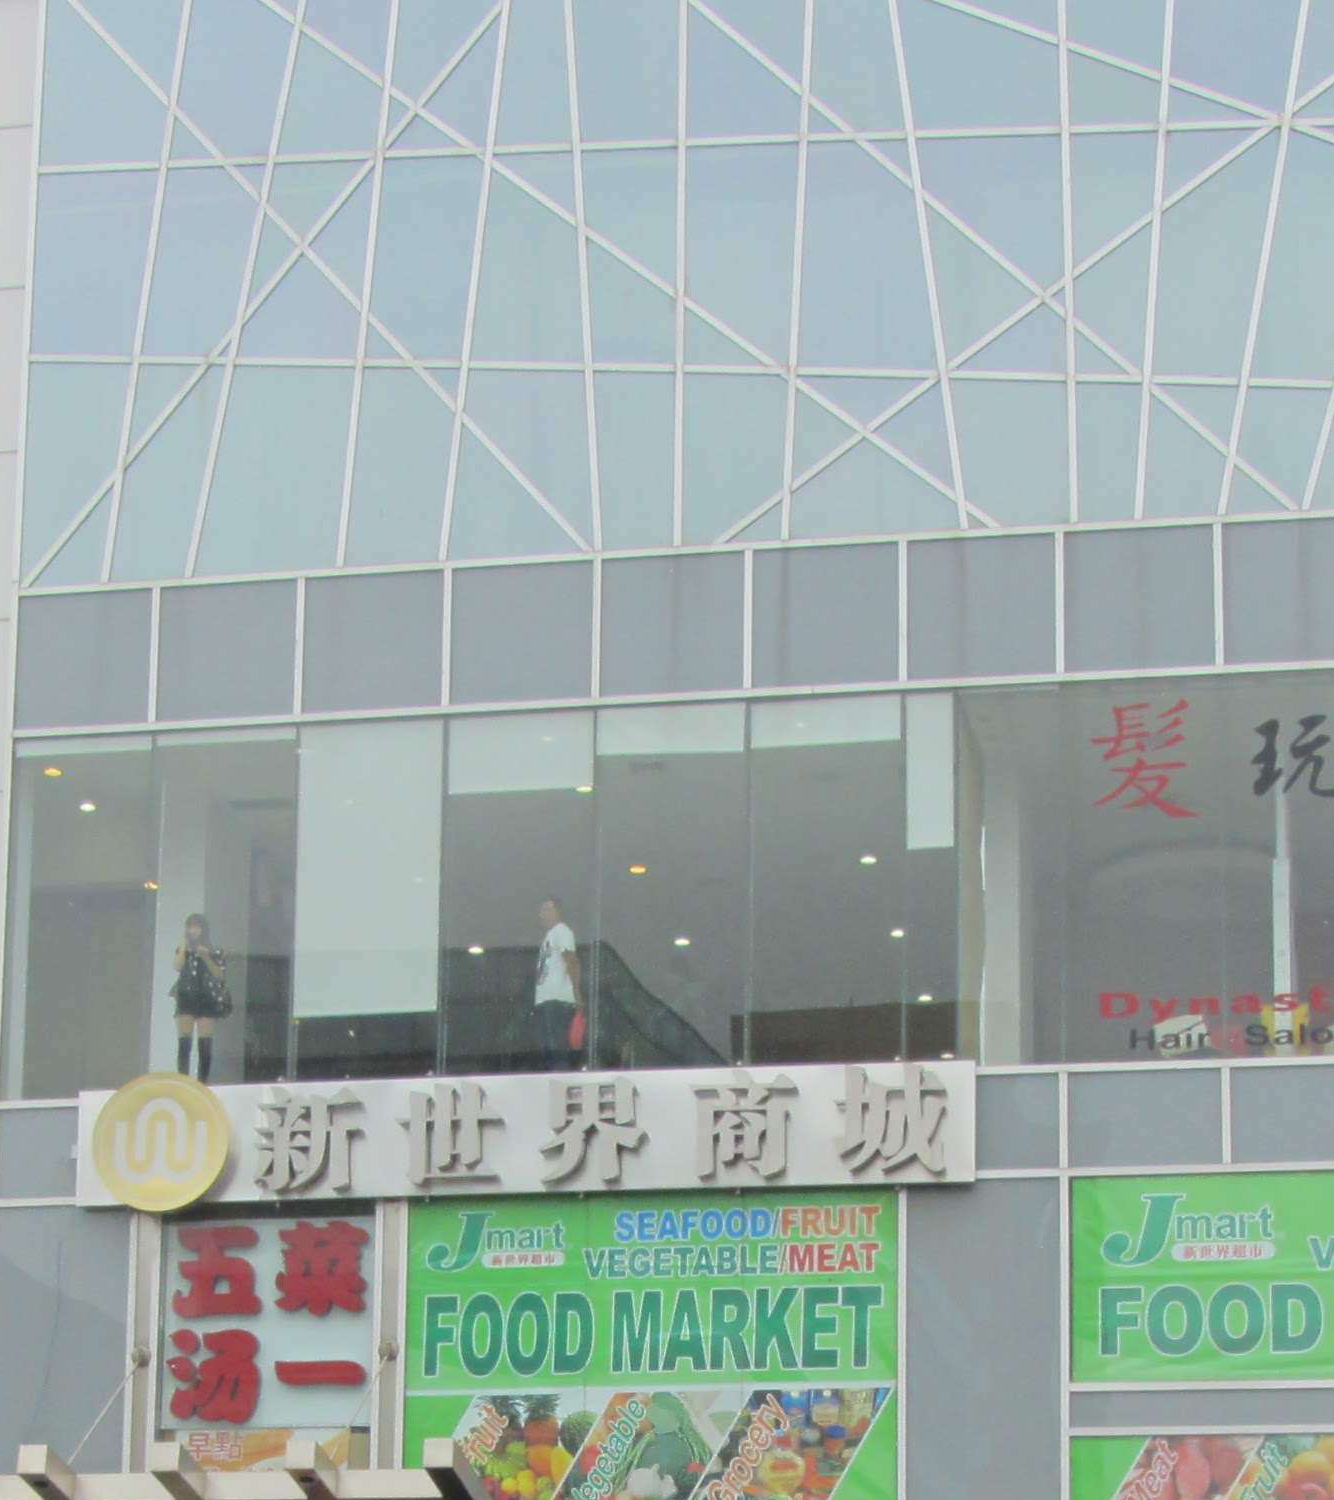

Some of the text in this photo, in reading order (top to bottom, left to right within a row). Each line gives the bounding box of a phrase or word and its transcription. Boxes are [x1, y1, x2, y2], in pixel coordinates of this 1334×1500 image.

[1129, 1028, 1210, 1051] Hair
[253, 1061, 951, 1194] 新世界商城
[613, 1205, 882, 1242] SEAFOOD/FRUIT
[584, 1242, 881, 1280] VEGETABLE/MEAT
[1182, 1242, 1265, 1260] 新世界超市
[422, 1284, 884, 1378] FOOD MARKET
[1098, 1280, 1325, 1358] FOOD
